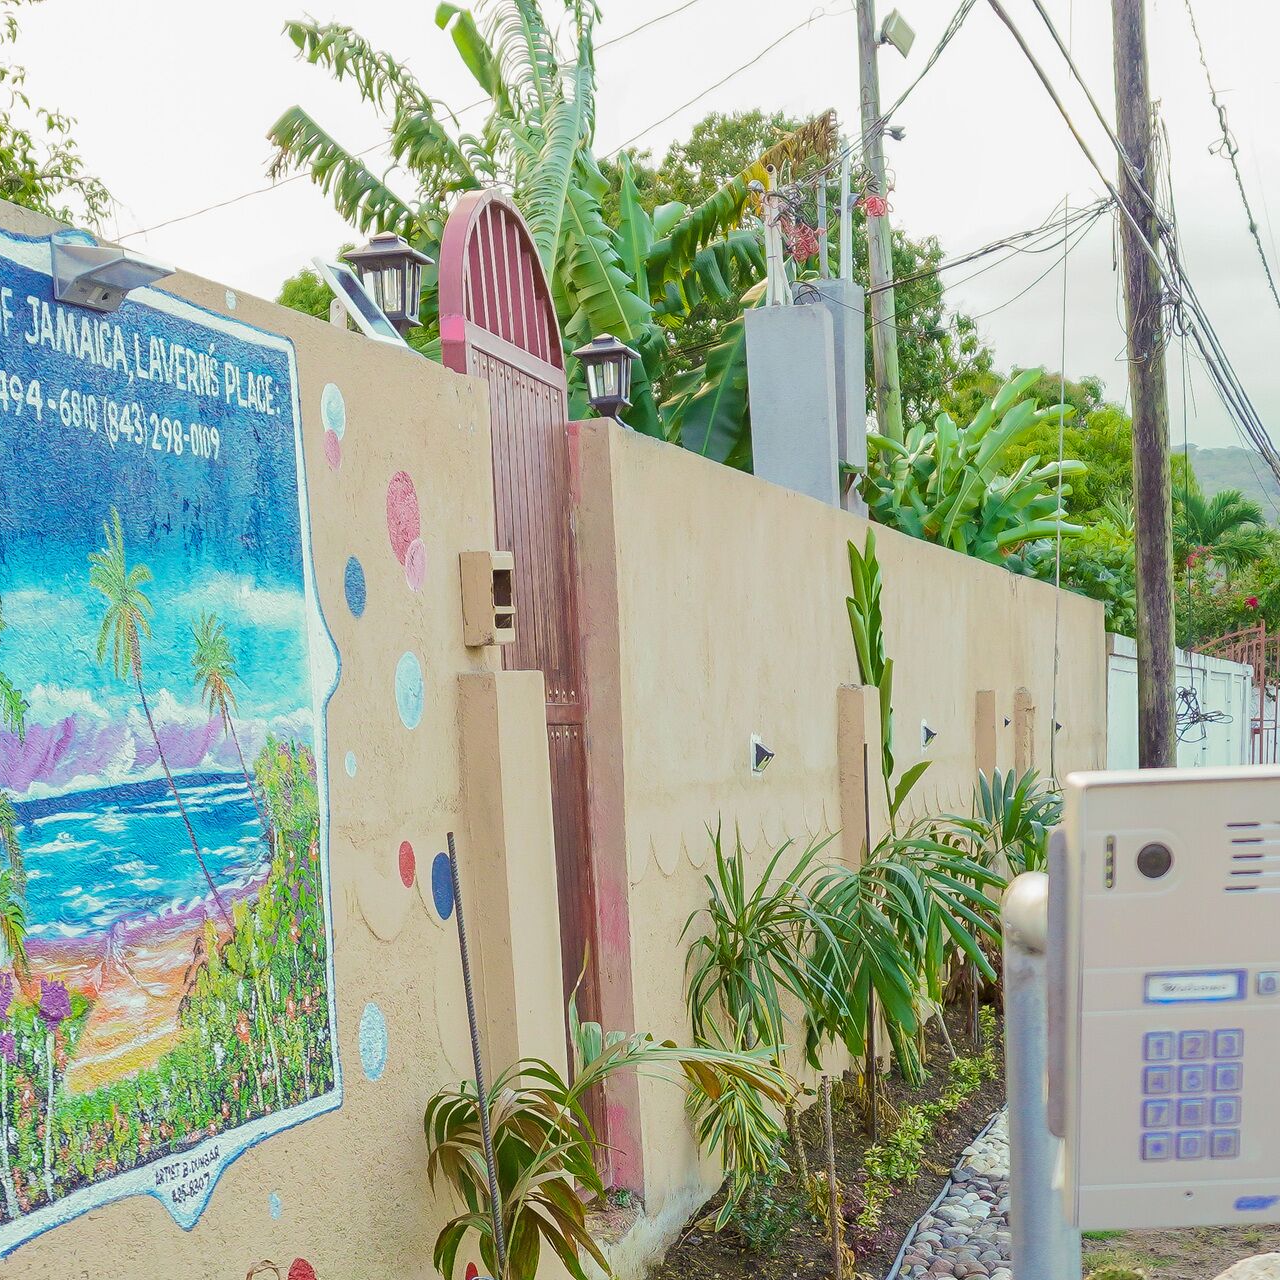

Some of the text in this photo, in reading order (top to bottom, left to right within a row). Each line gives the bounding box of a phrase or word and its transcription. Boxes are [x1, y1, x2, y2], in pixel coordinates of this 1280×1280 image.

[103, 393, 148, 458] (843)
[149, 412, 220, 461] 298-0109
[155, 1162, 180, 1186] ARTIST
